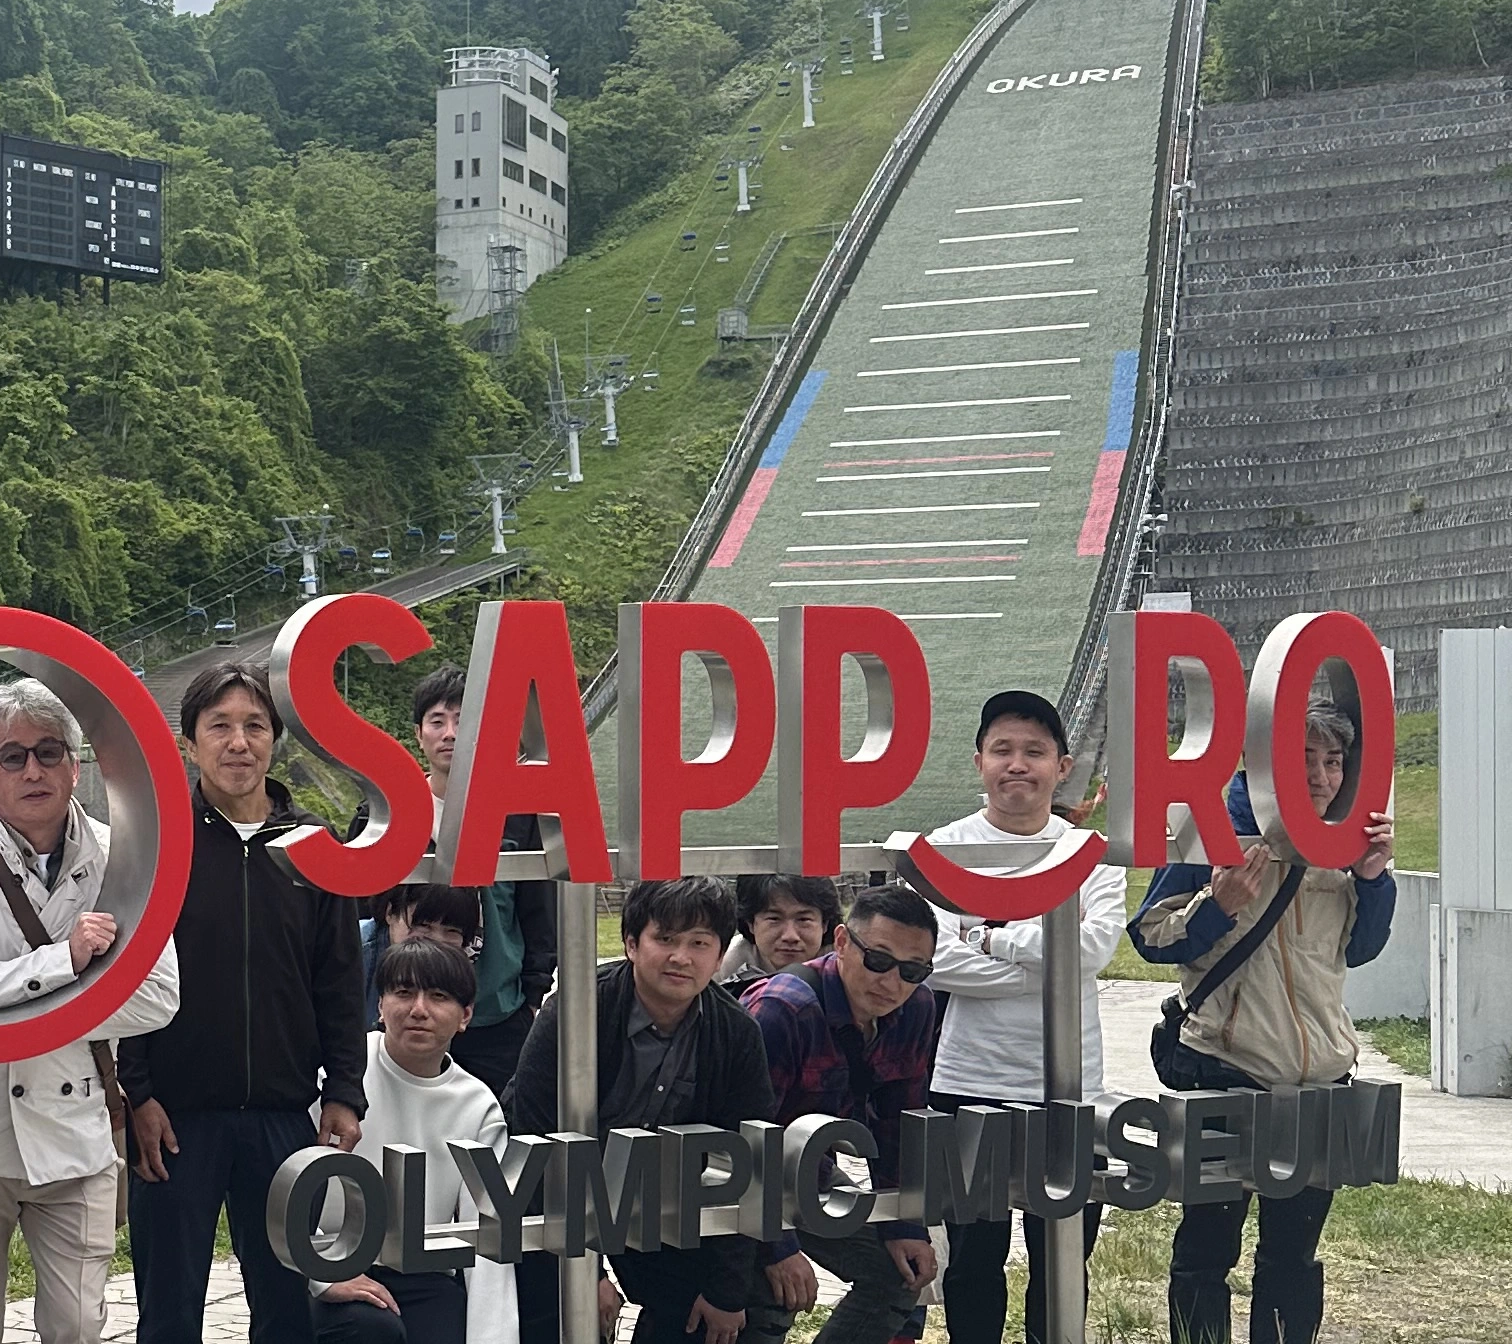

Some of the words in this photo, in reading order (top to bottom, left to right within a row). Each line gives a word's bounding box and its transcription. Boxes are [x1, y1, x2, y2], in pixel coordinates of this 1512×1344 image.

[986, 64, 1142, 94] OKURA
[7, 167, 12, 178] 1
[6, 181, 12, 193] 2
[111, 186, 116, 196] A
[6, 195, 12, 207] 3
[6, 210, 12, 221] 4
[111, 213, 116, 224] C
[6, 224, 12, 235] 5
[6, 238, 12, 250] 6
[111, 241, 116, 252] E
[267, 1113, 879, 1283] OLYMPIC
[900, 1078, 1402, 1226] MUSEUM
